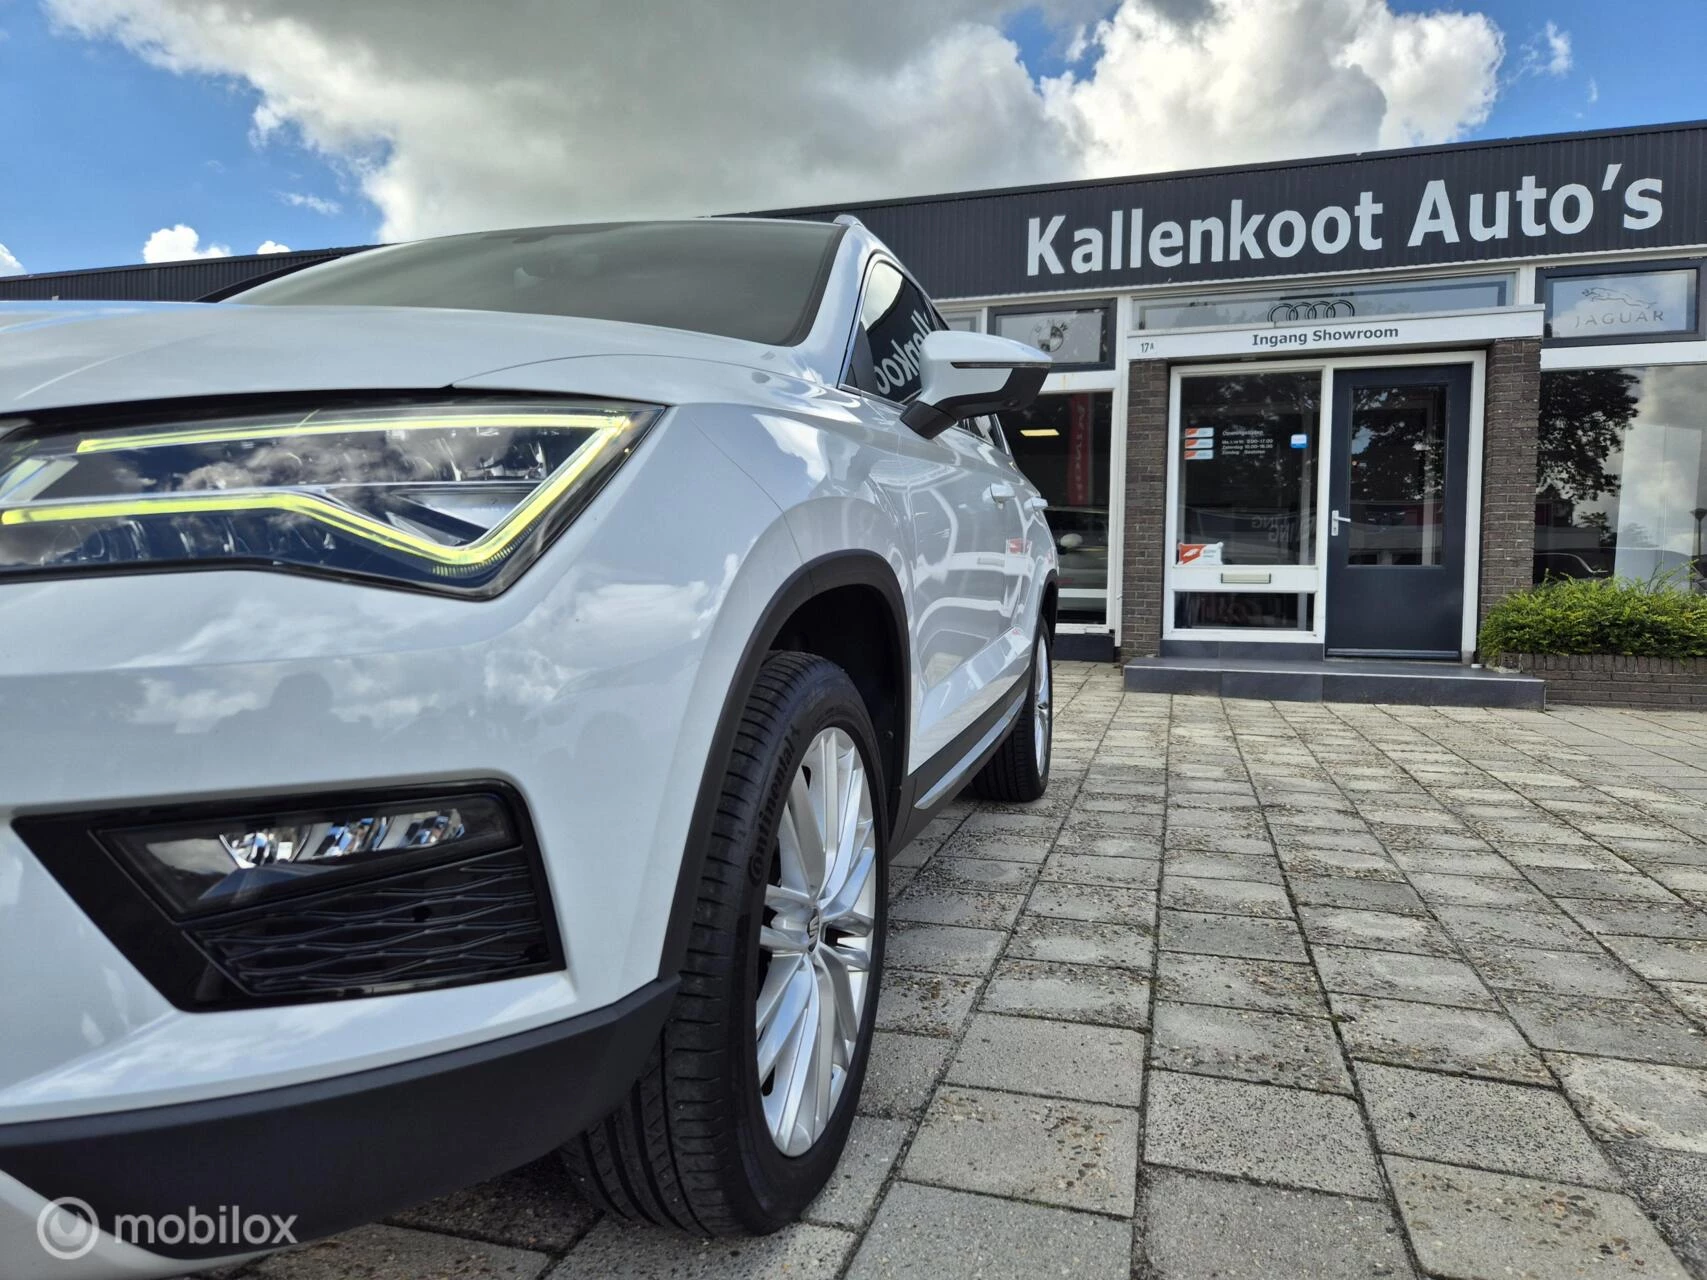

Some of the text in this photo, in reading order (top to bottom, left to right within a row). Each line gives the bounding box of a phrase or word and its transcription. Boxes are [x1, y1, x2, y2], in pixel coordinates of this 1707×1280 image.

[1026, 191, 1384, 277] Kallenkoot
[1252, 328, 1399, 348] Ingang Showroom
[1575, 310, 1664, 328] JAGUAR
[748, 735, 796, 887] Continental
